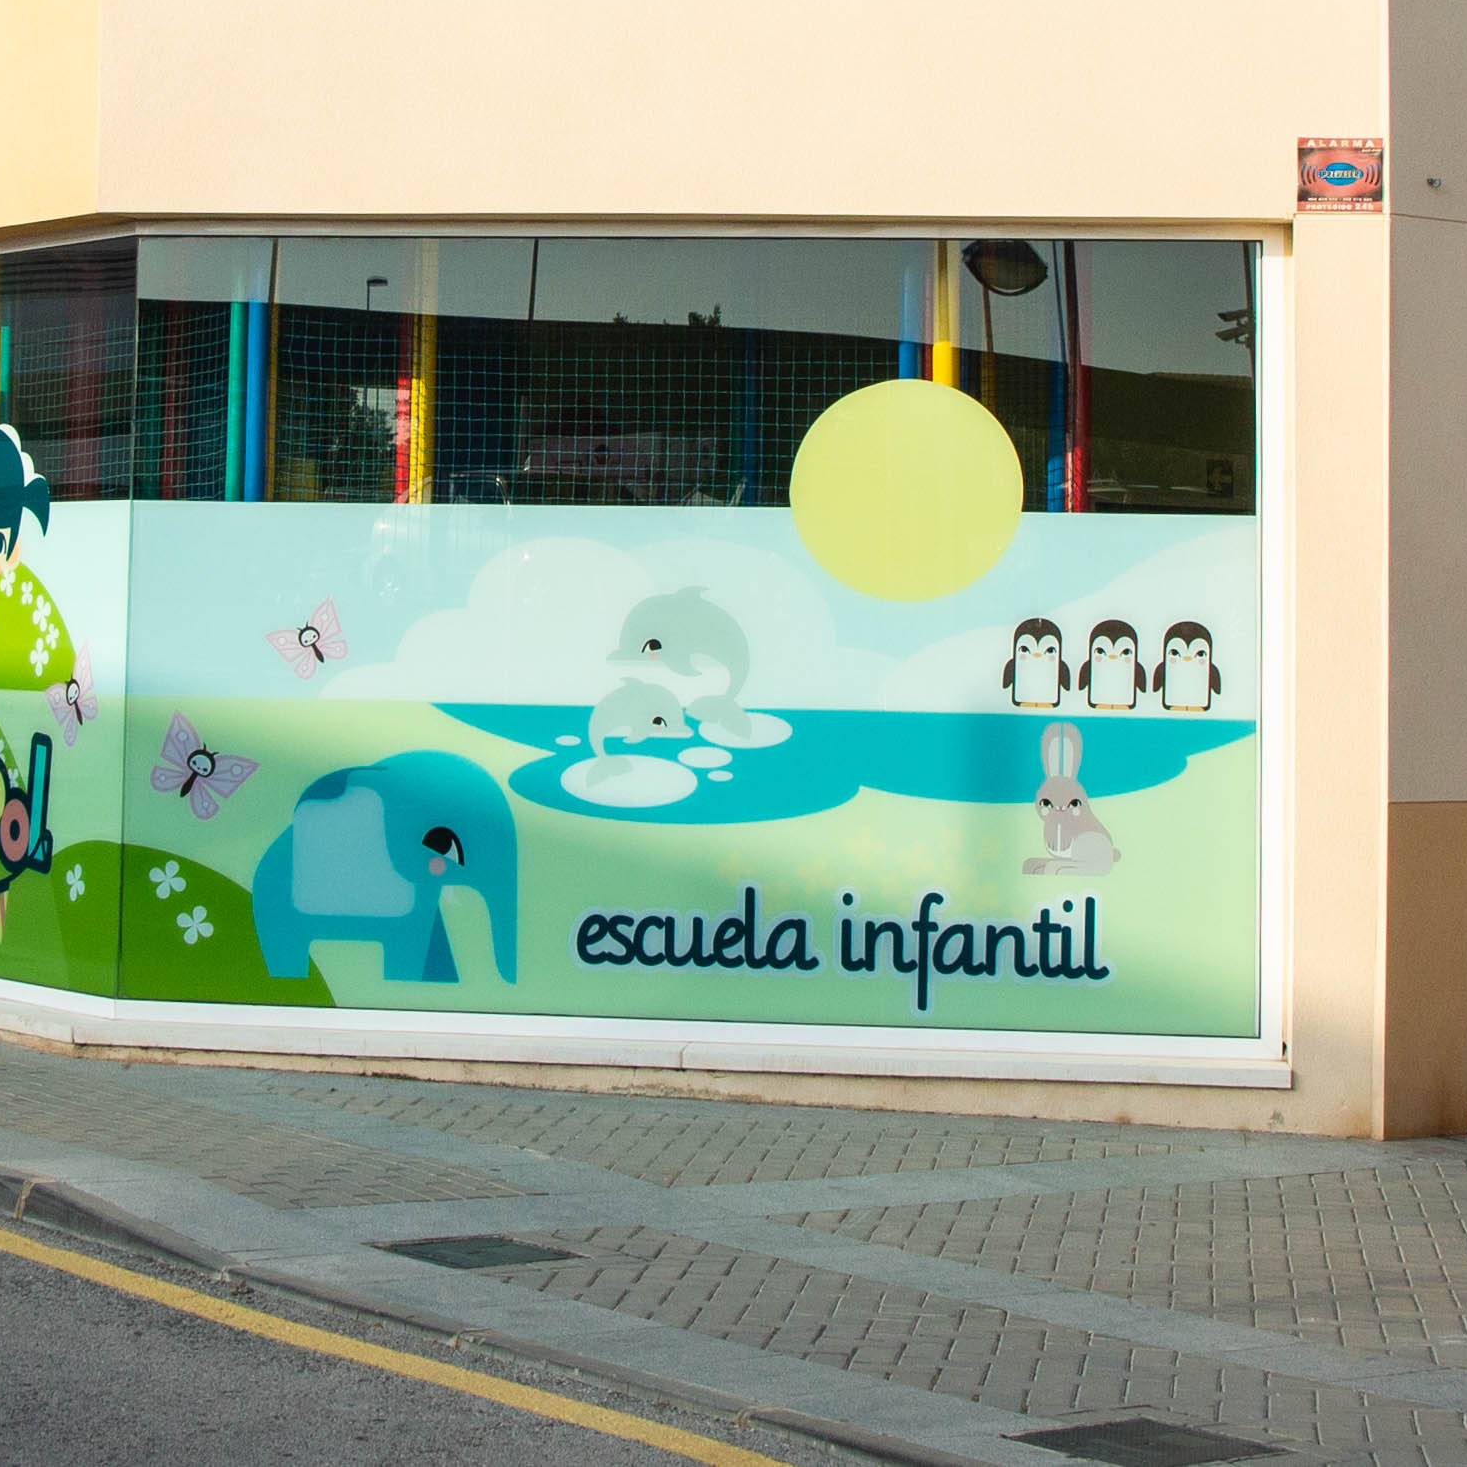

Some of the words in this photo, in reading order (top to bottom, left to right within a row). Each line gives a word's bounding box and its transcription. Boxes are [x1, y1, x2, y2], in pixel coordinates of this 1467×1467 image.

[1307, 139, 1375, 148] ALARMA
[576, 887, 819, 971] escuela
[840, 893, 1110, 1010] infantil
